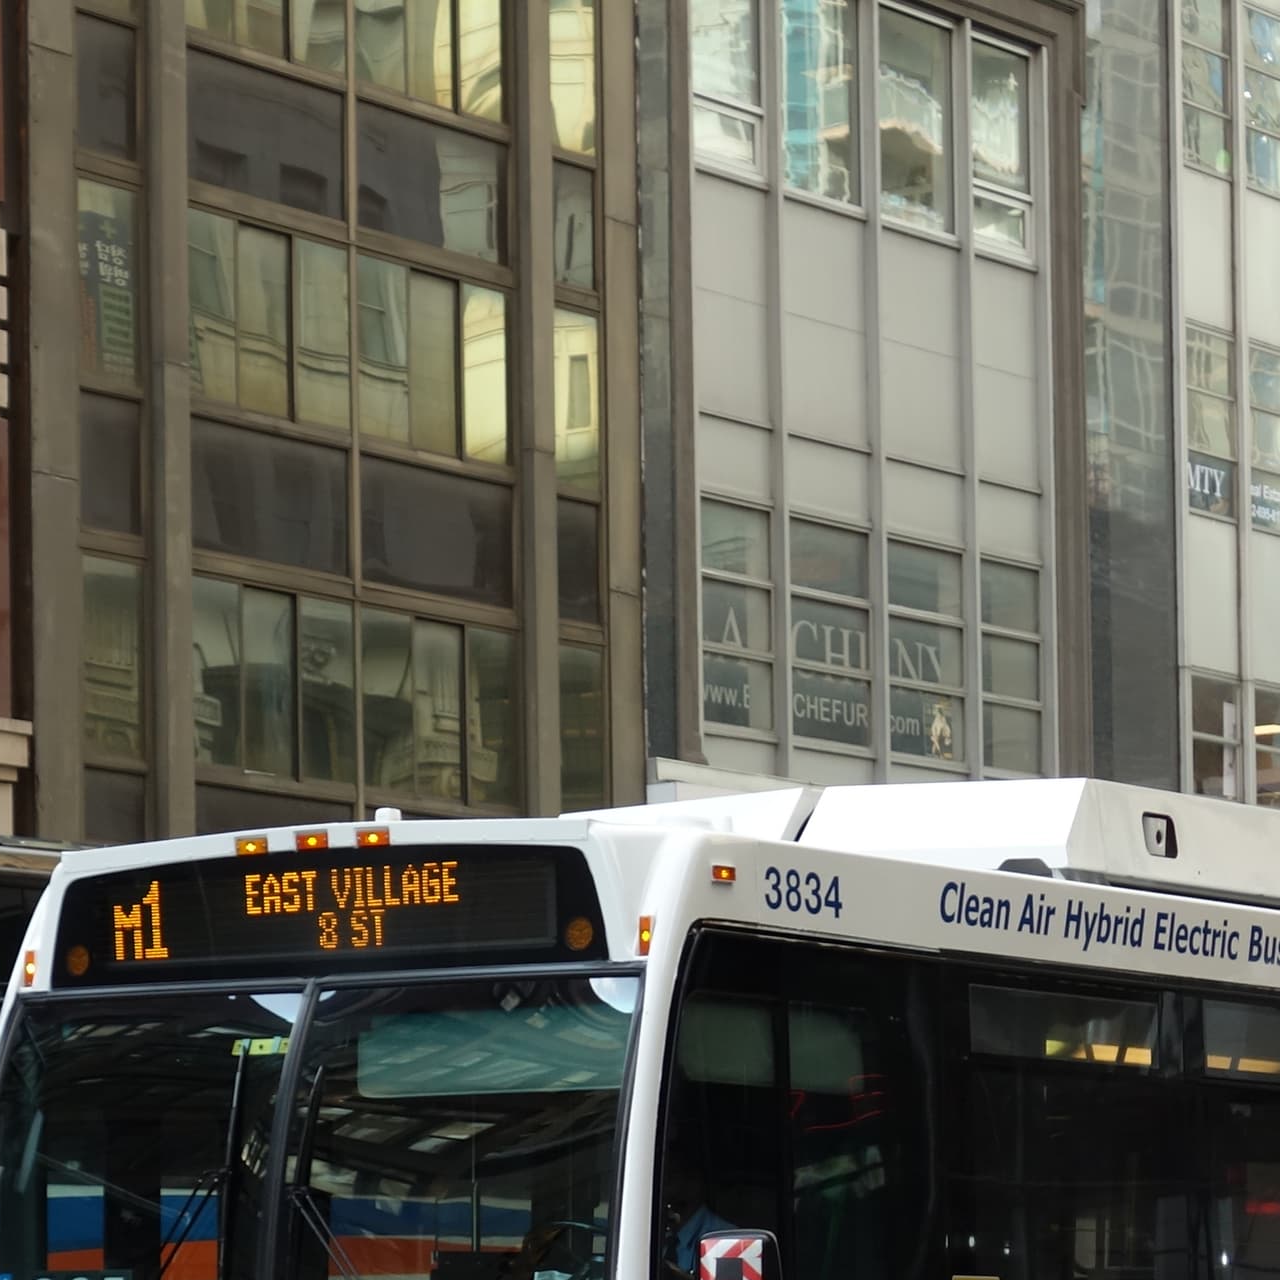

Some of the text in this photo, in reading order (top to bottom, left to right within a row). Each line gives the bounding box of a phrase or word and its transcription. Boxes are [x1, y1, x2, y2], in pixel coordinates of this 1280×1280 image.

[244, 861, 460, 915] EAST VILLAGE
[763, 866, 843, 919] 3834
[112, 879, 170, 961] M1
[318, 908, 386, 949] 8 ST
[938, 881, 1011, 930] Clean
[1017, 892, 1056, 936] Air
[1063, 899, 1145, 953] Hybrid
[1152, 911, 1240, 960] Electric
